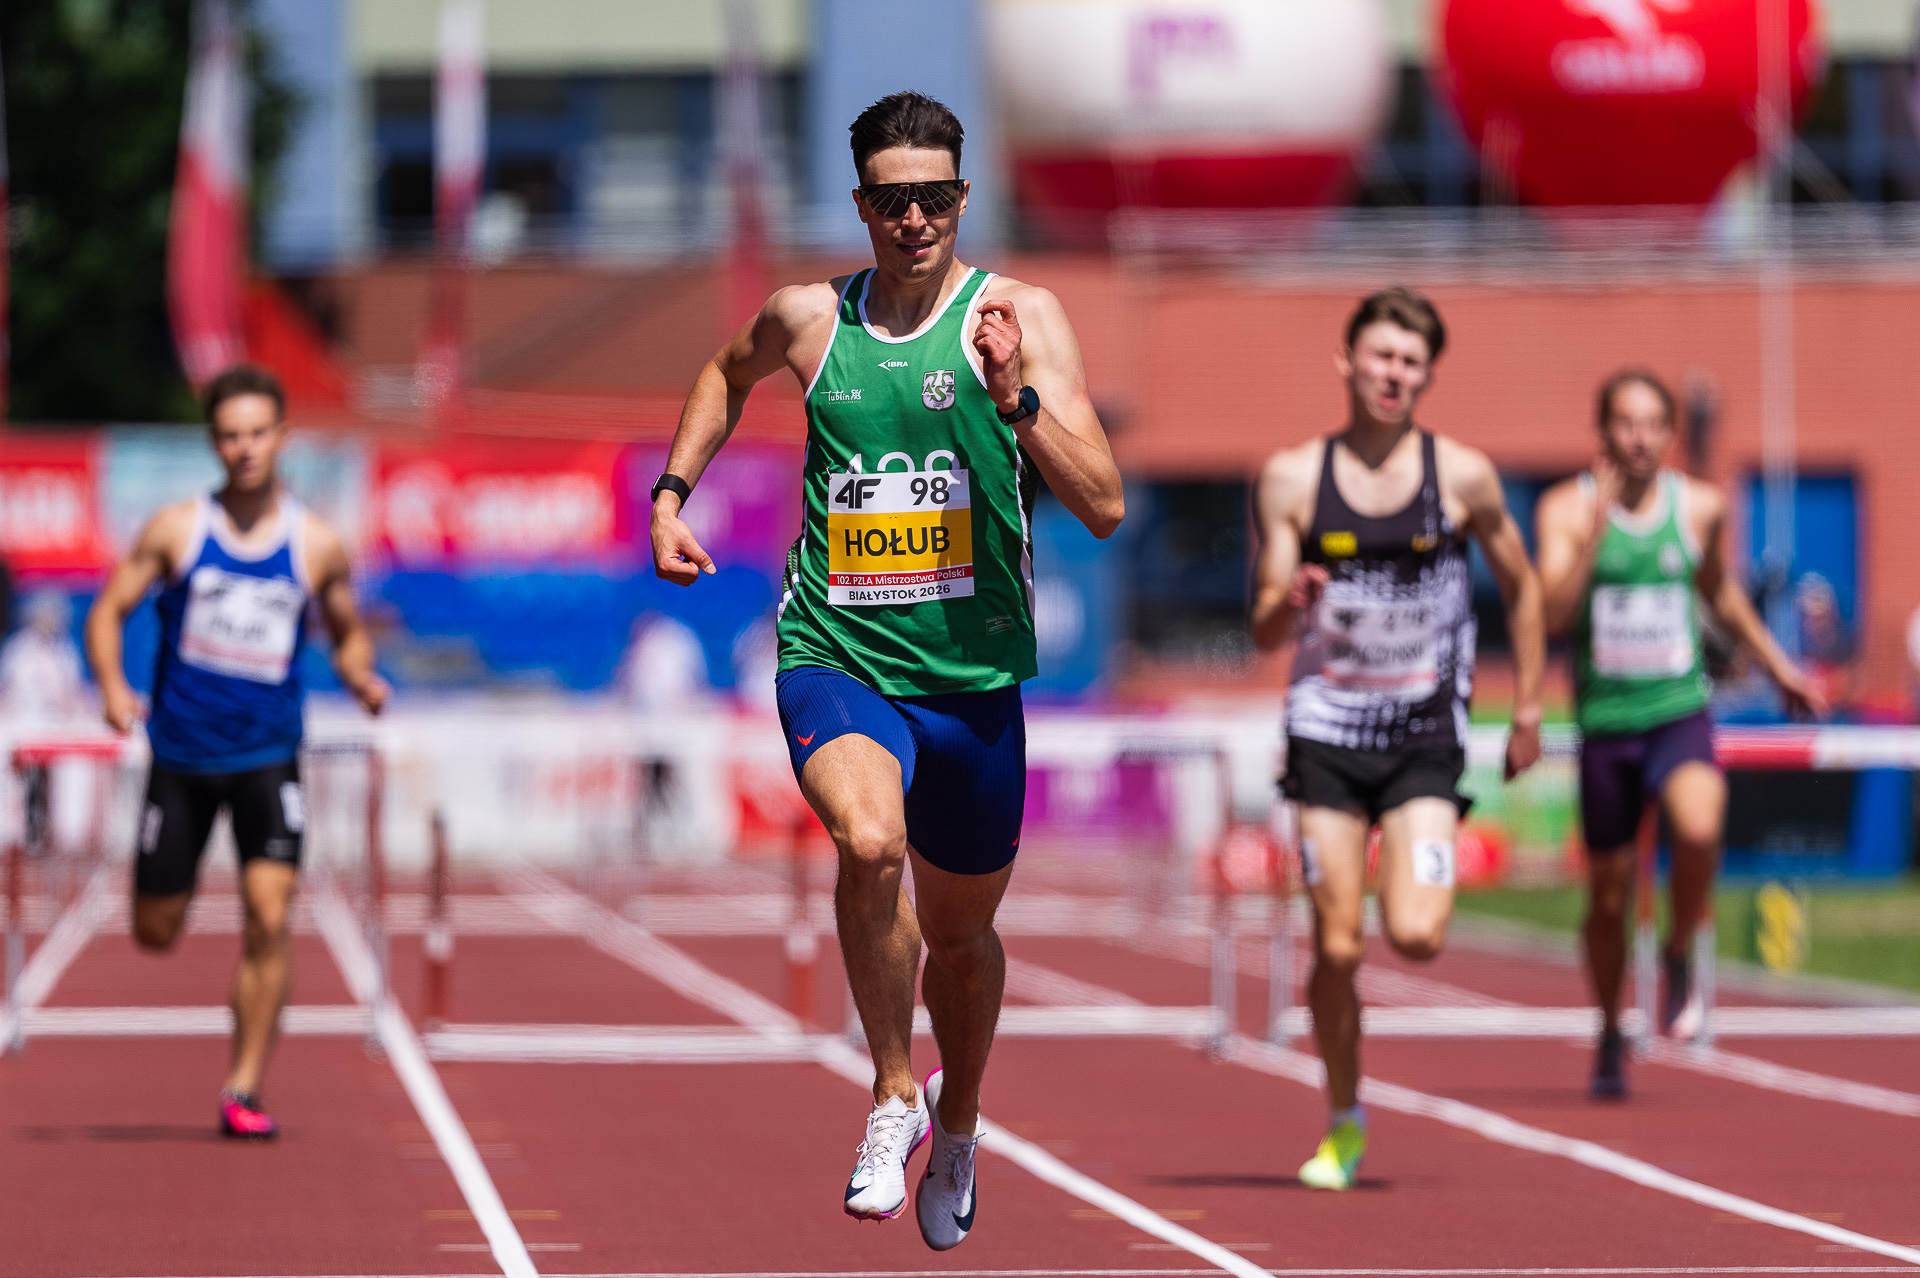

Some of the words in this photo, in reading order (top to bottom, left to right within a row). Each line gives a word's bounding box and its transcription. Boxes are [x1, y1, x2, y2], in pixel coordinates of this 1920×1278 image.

[834, 478, 882, 509] 4F
[910, 476, 950, 506] 98
[844, 525, 951, 557] HOŁUB
[853, 576, 873, 585] PZLA
[875, 573, 935, 585] Mistrzostwa
[936, 568, 966, 581] Polski
[848, 588, 917, 601] BIAŁYSTOK
[919, 584, 951, 598] 2026
